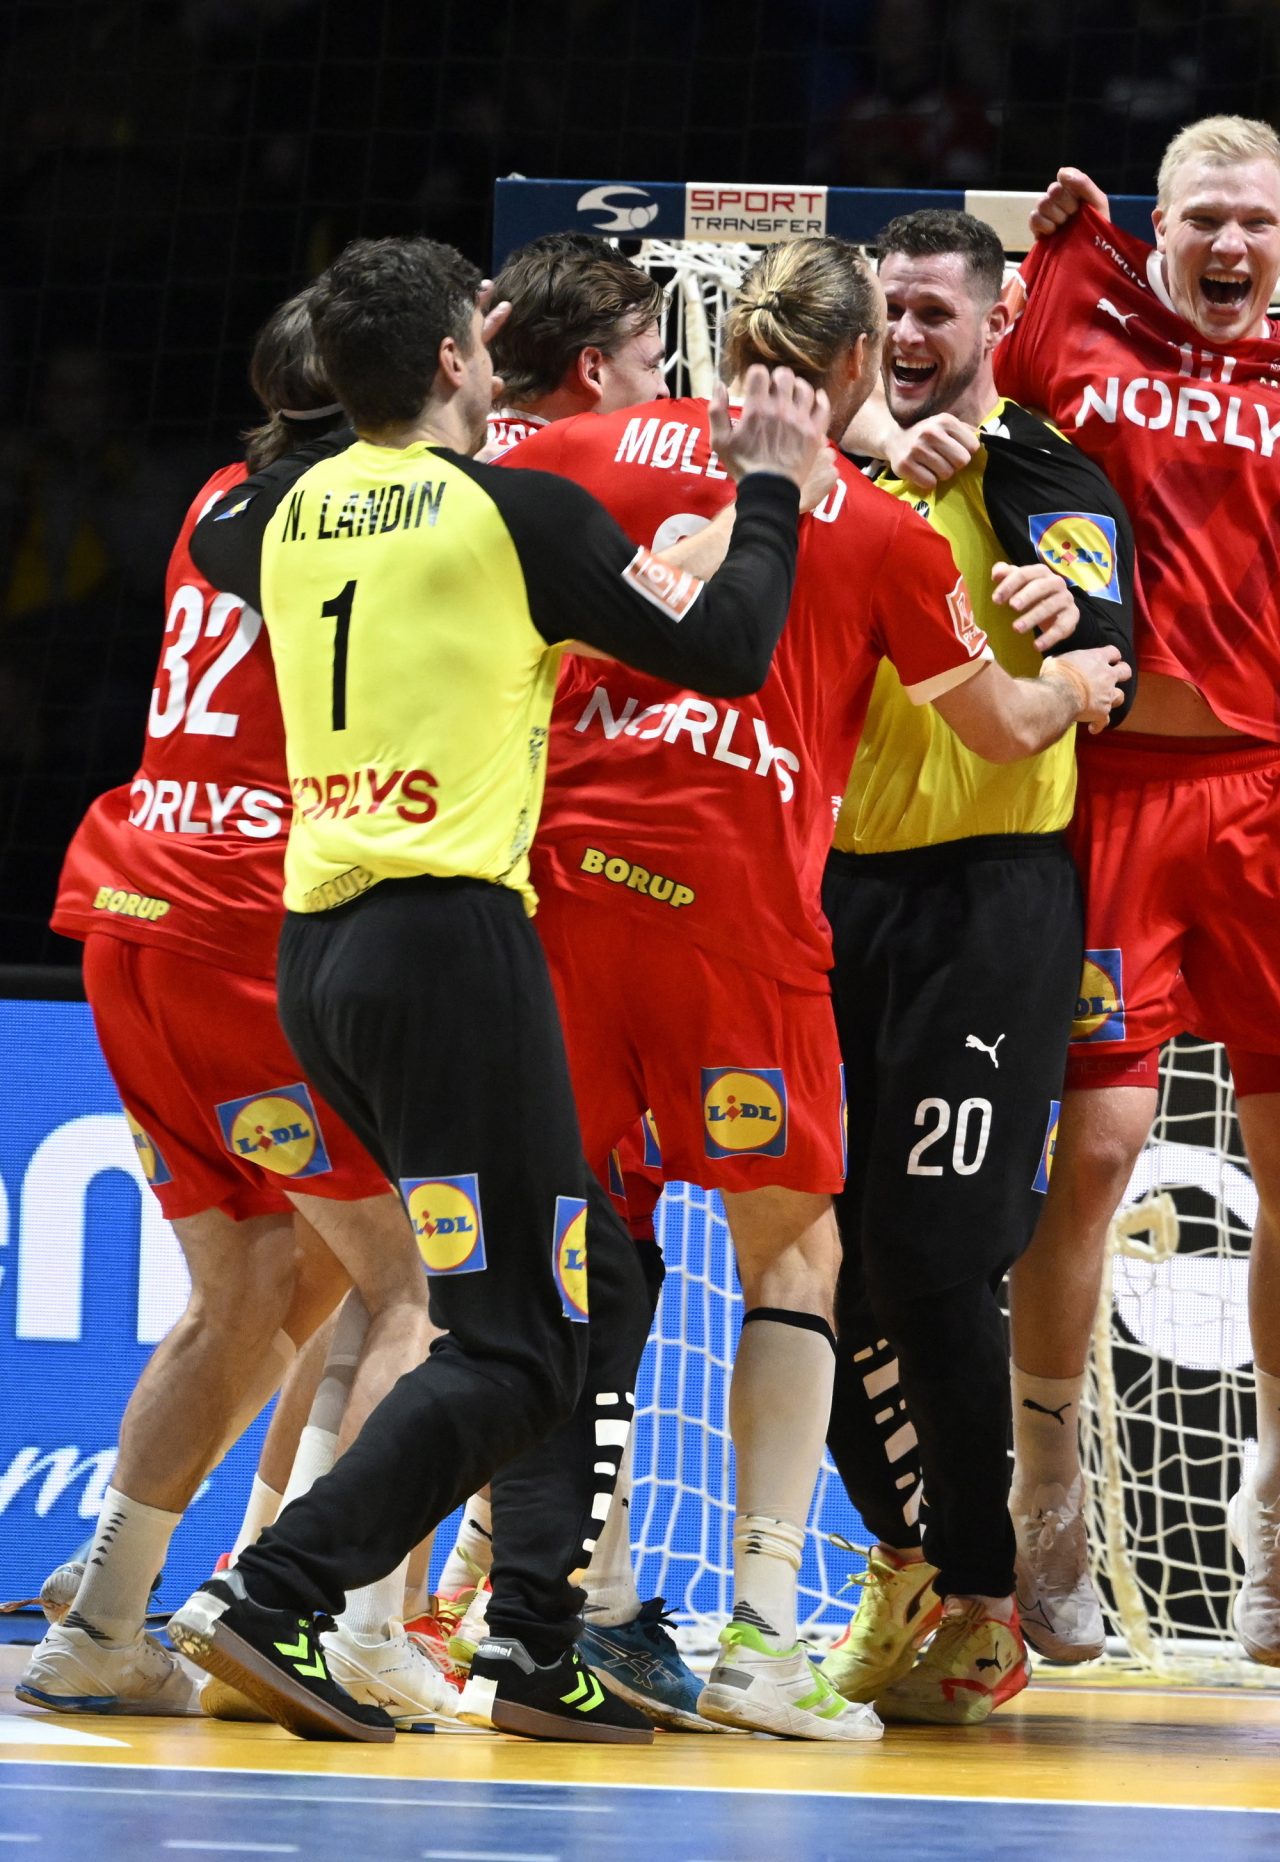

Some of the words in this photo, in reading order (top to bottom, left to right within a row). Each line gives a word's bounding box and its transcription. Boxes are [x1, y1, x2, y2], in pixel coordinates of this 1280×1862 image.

[691, 190, 822, 214] SPORT
[691, 217, 822, 233] TRANSFER
[281, 490, 305, 543] N.
[317, 480, 448, 541] LANDIN
[147, 585, 263, 739] 32
[321, 580, 357, 732] 1
[574, 686, 800, 803] NORLYS
[292, 768, 440, 824] ORLYS
[93, 886, 171, 922] BORUP
[579, 848, 695, 908] BORUP
[907, 1097, 992, 1177] 20
